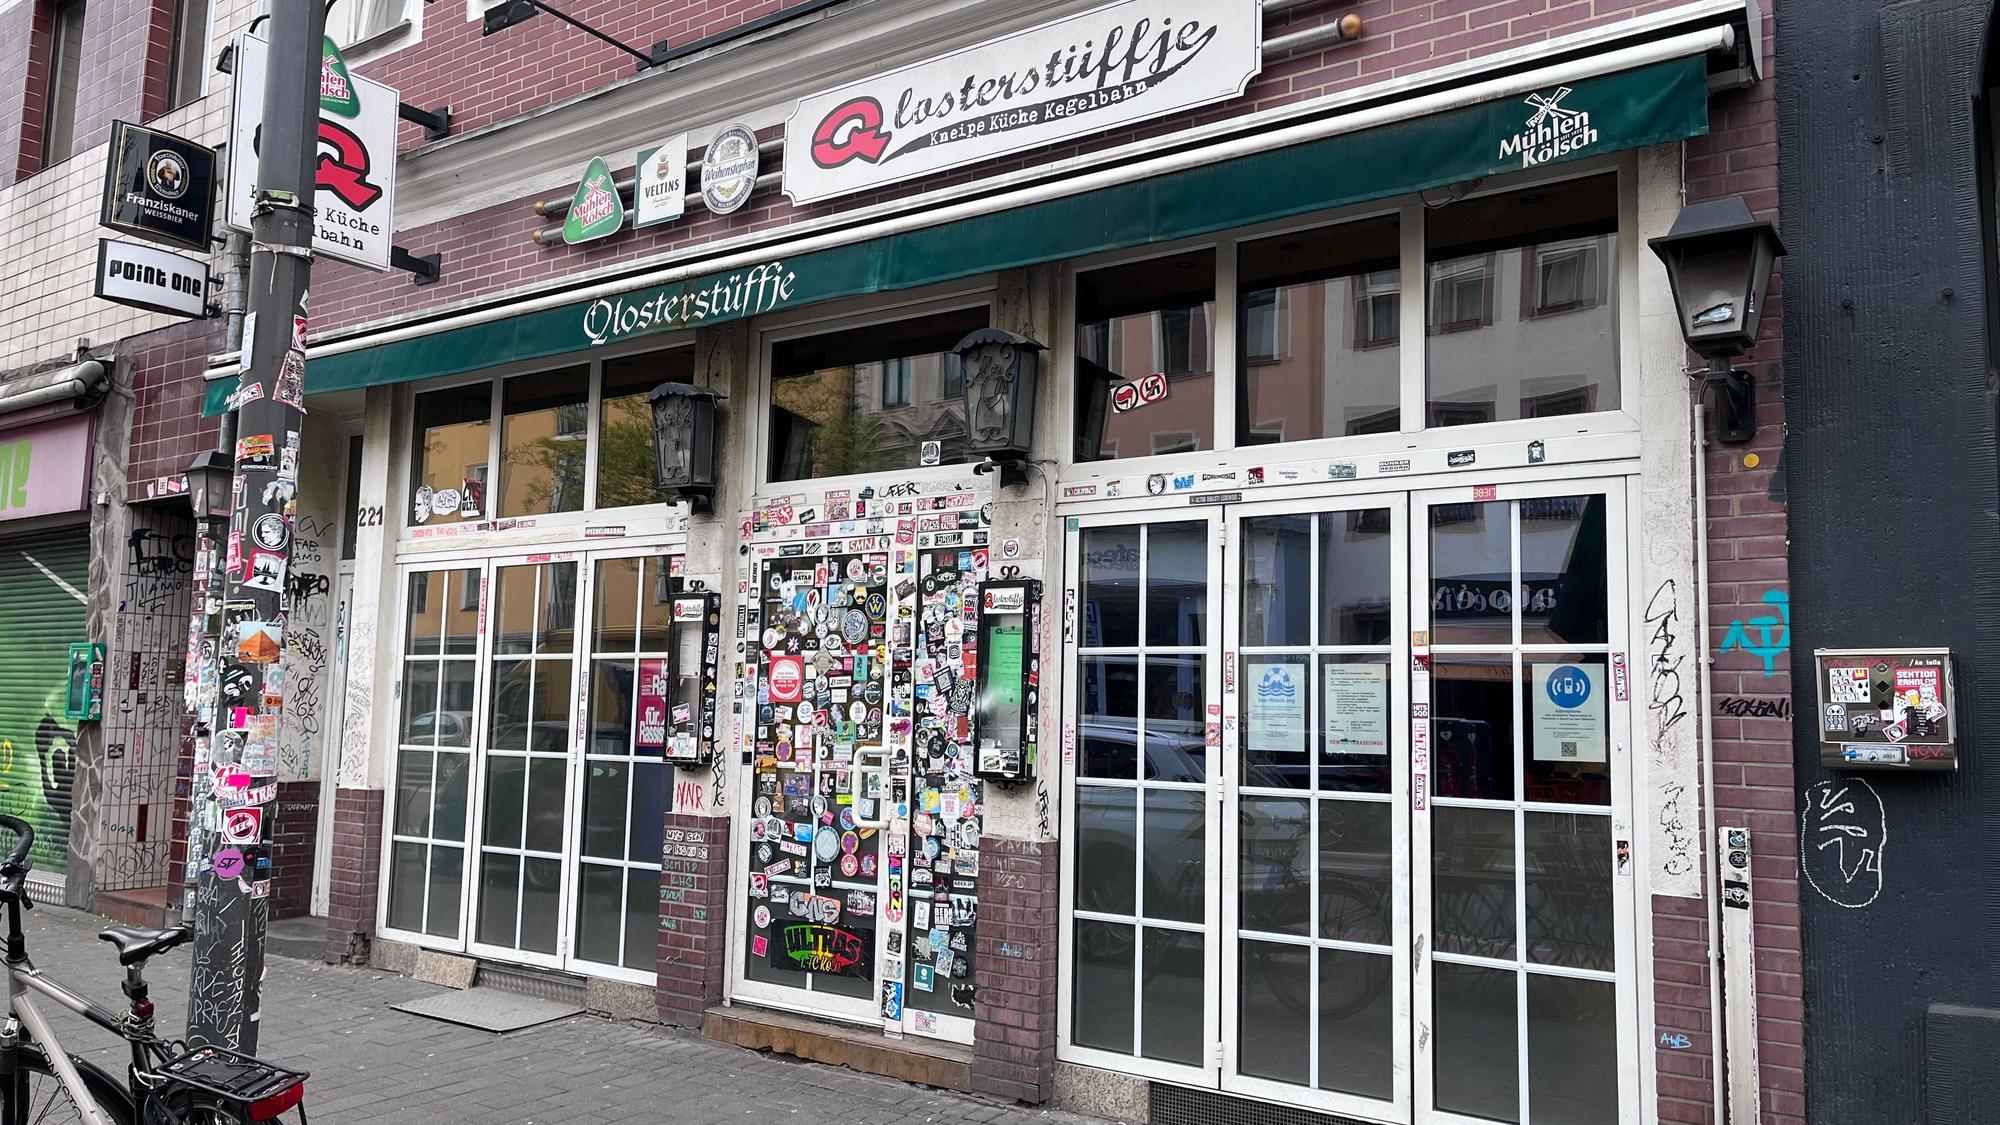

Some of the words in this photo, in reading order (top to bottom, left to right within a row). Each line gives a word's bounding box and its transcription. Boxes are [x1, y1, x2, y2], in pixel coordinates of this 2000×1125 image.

[321, 84, 350, 99] ölsch
[930, 120, 985, 147] Kneipe
[989, 108, 1039, 131] Küche
[1044, 81, 1148, 121] Kegelbahn
[1499, 111, 1589, 160] Mühlen
[1522, 125, 1598, 169] Kölsch
[704, 158, 756, 183] Weihenstephan
[644, 178, 681, 199] VELTINS
[126, 192, 200, 223] Franziskaner
[144, 207, 184, 225] WEISSBIER
[573, 192, 612, 222] Mühlen
[581, 203, 616, 228] Kölsch
[325, 207, 380, 236] Küche
[1474, 488, 1496, 498] 38317
[358, 505, 384, 528] 221
